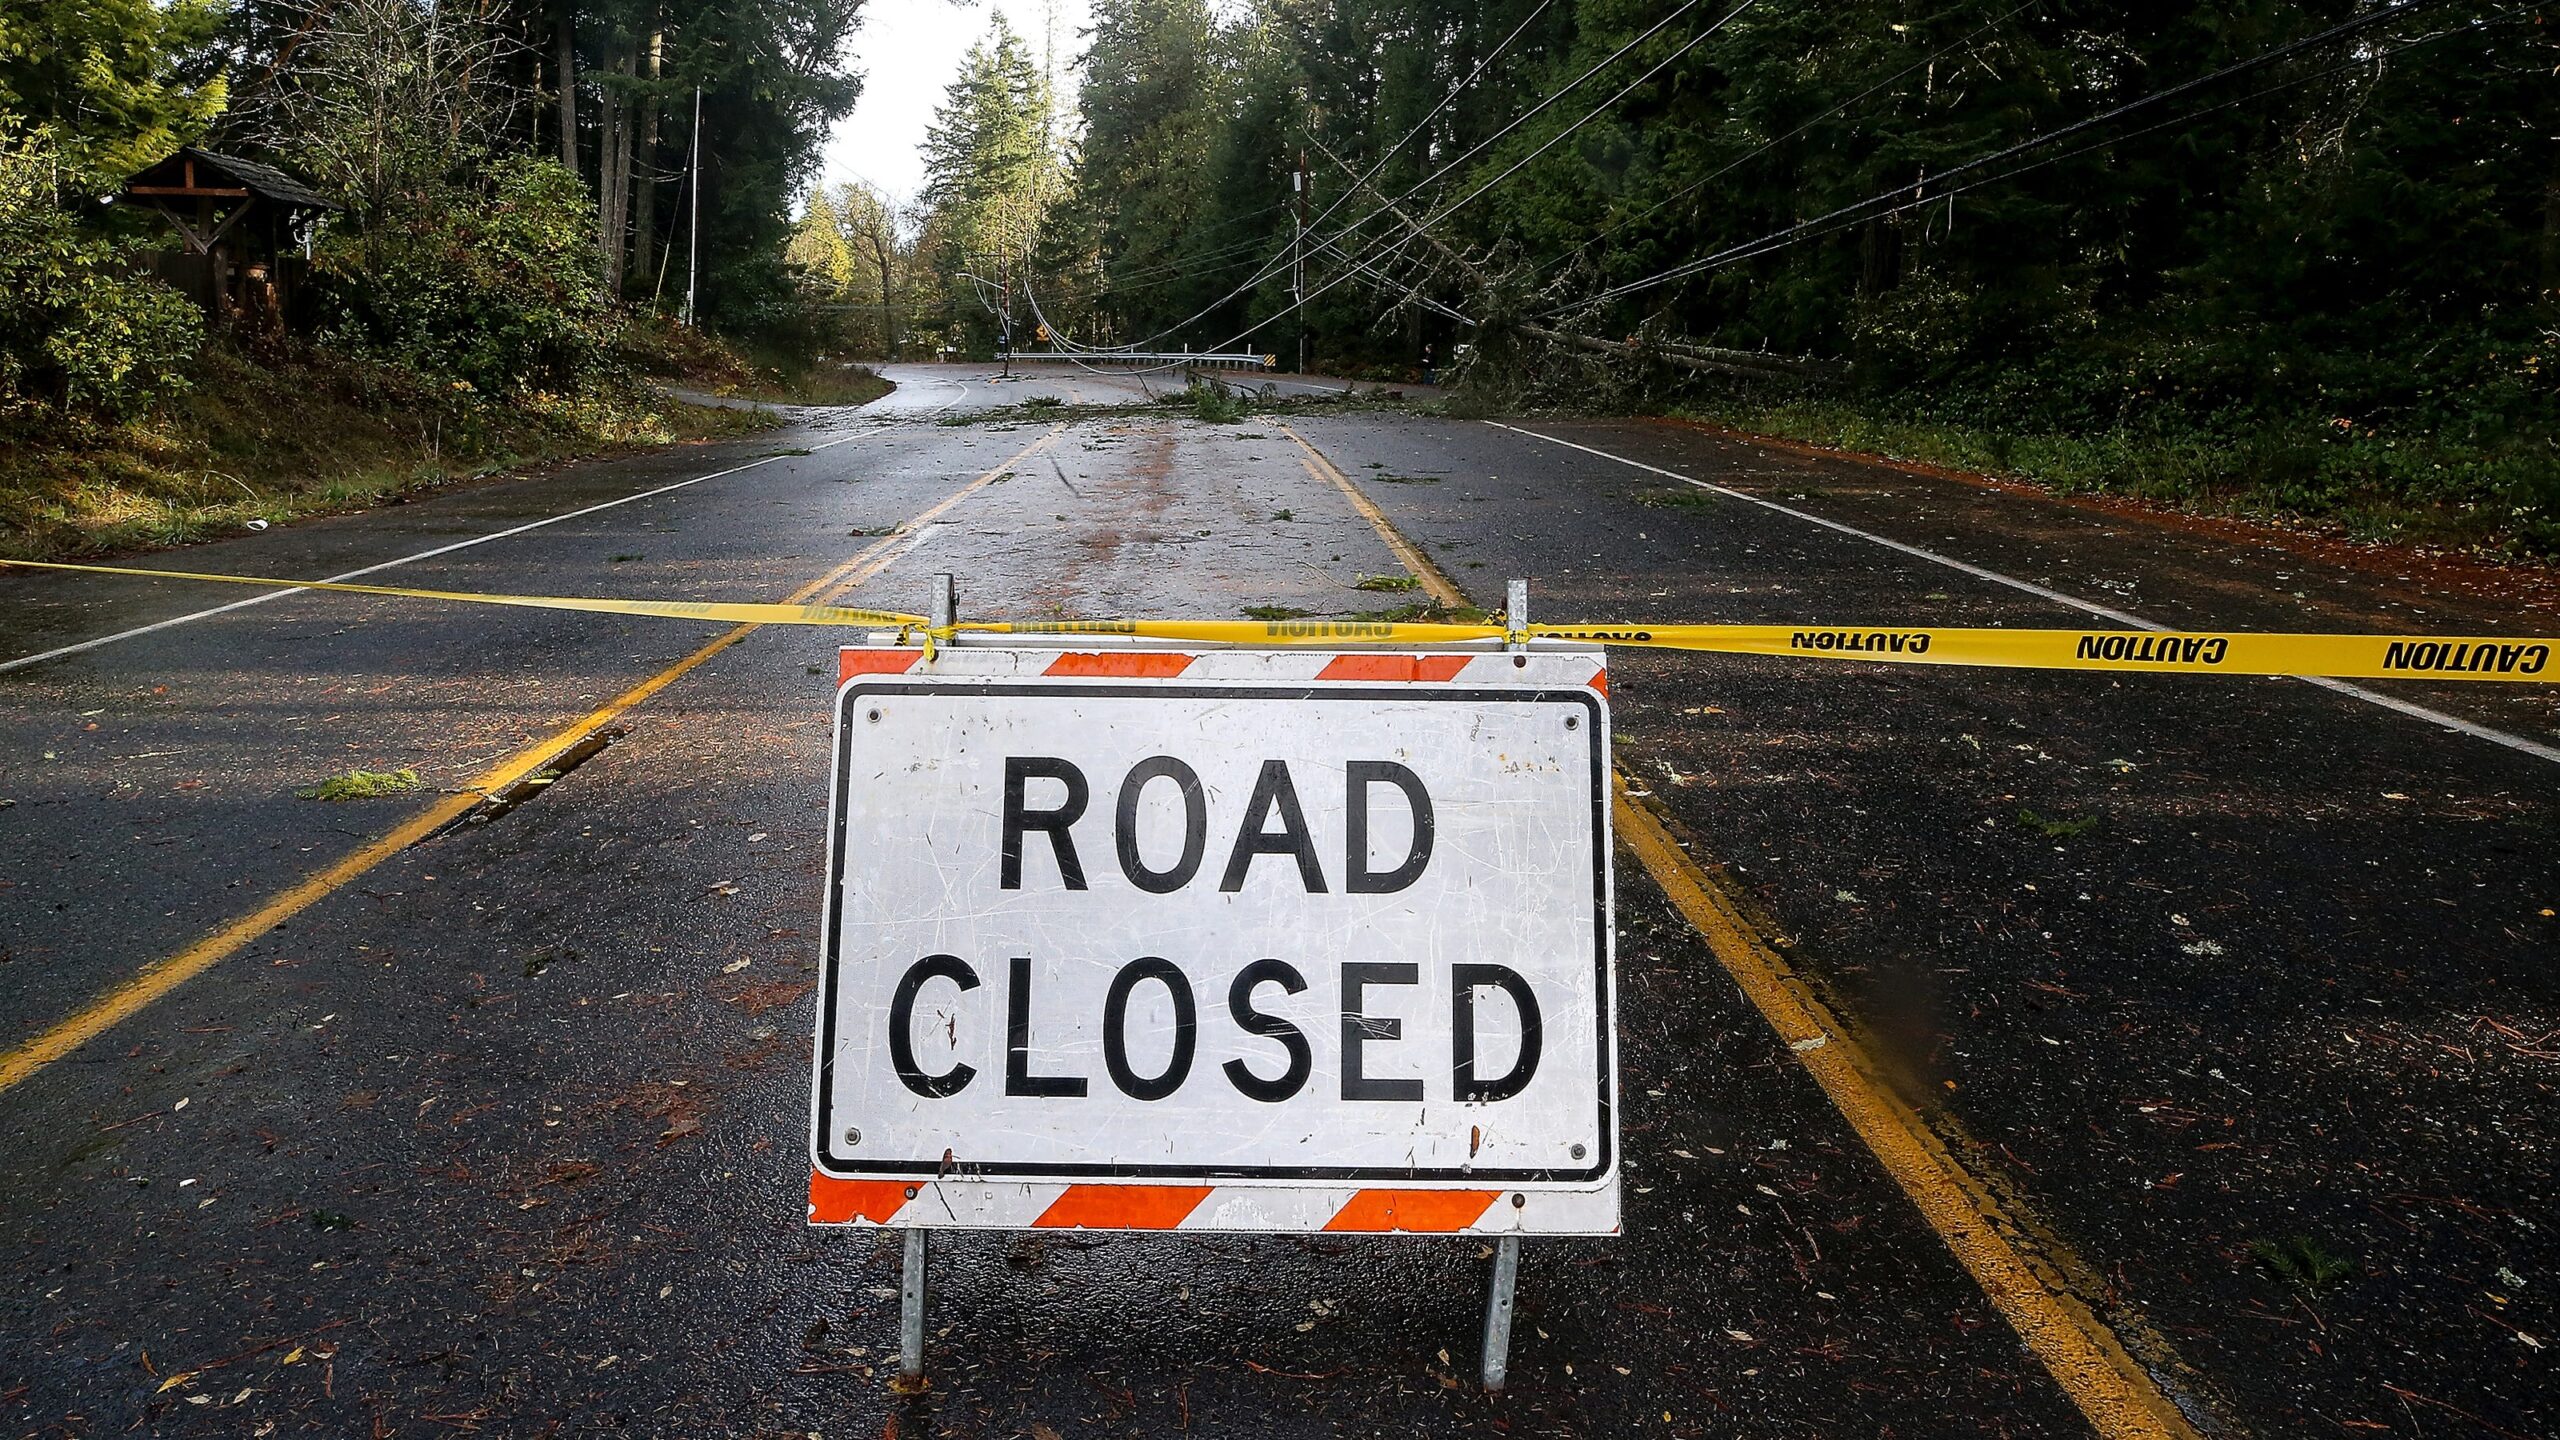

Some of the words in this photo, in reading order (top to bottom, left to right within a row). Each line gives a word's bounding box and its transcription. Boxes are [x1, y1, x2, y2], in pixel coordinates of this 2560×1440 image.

[1791, 632, 1932, 654] CAUTION
[2076, 635, 2229, 664] CAUTION
[2382, 642, 2550, 674] CAUTION
[1000, 756, 1435, 893] ROAD
[888, 954, 1543, 1103] CLOSED
